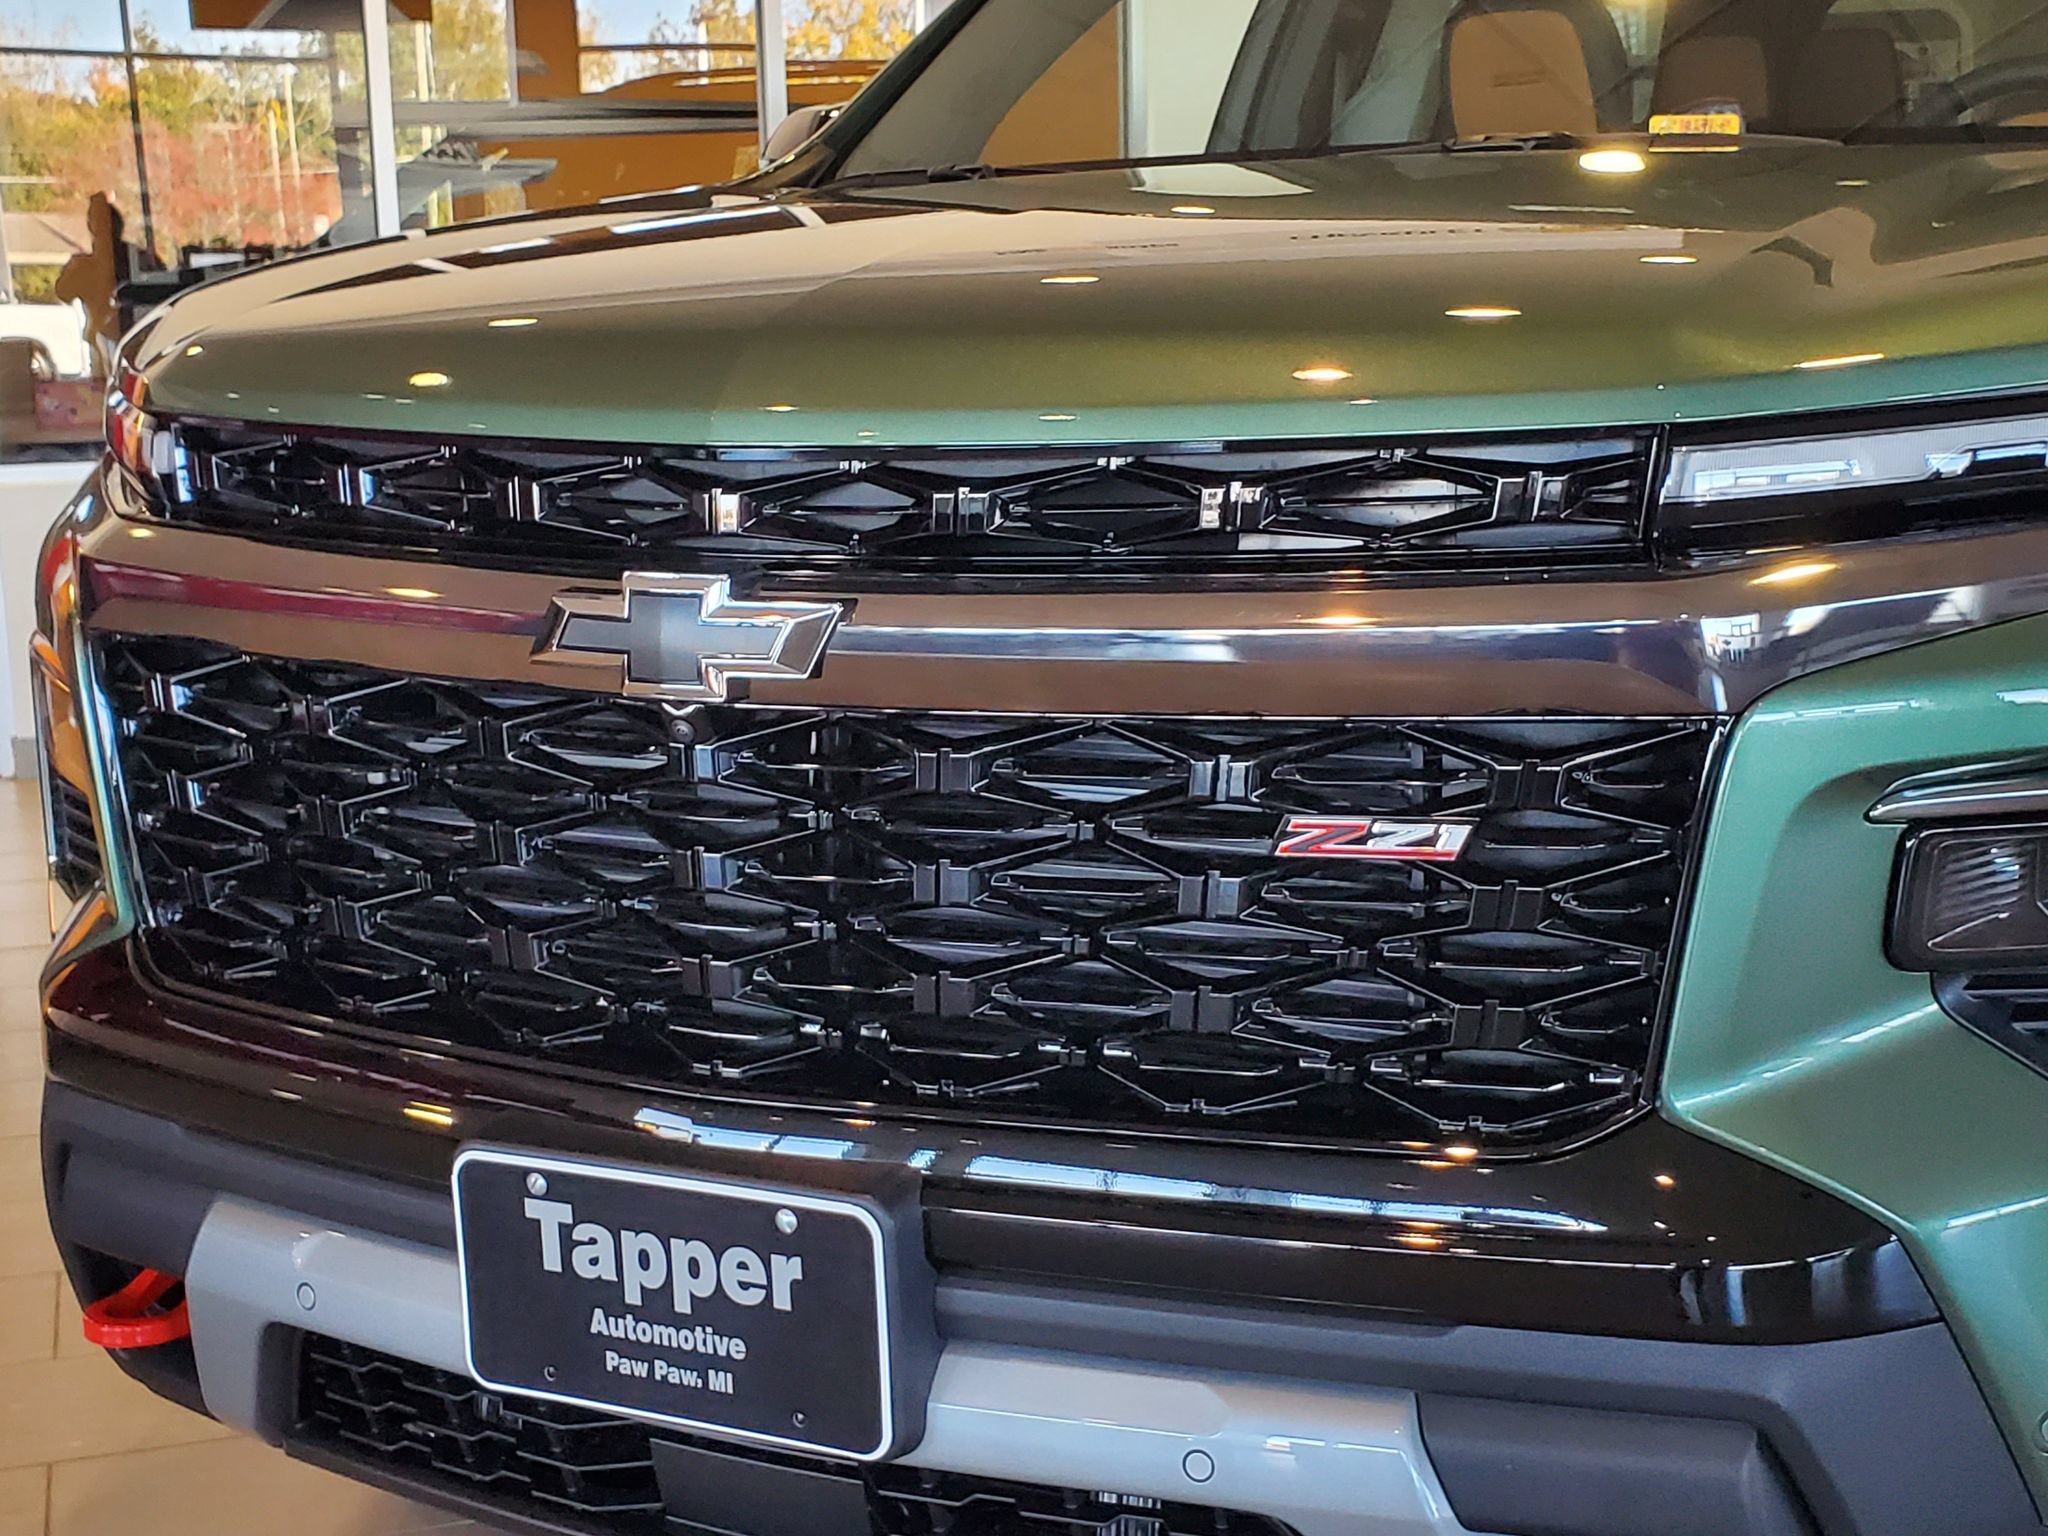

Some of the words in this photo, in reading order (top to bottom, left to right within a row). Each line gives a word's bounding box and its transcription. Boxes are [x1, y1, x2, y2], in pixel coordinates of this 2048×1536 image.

[1275, 817, 1474, 861] Z71
[524, 1197, 803, 1315] Tapper
[590, 1308, 748, 1361] Automotive
[605, 1350, 649, 1379] Paw
[654, 1359, 703, 1389] Paw,
[707, 1369, 734, 1395] MI
